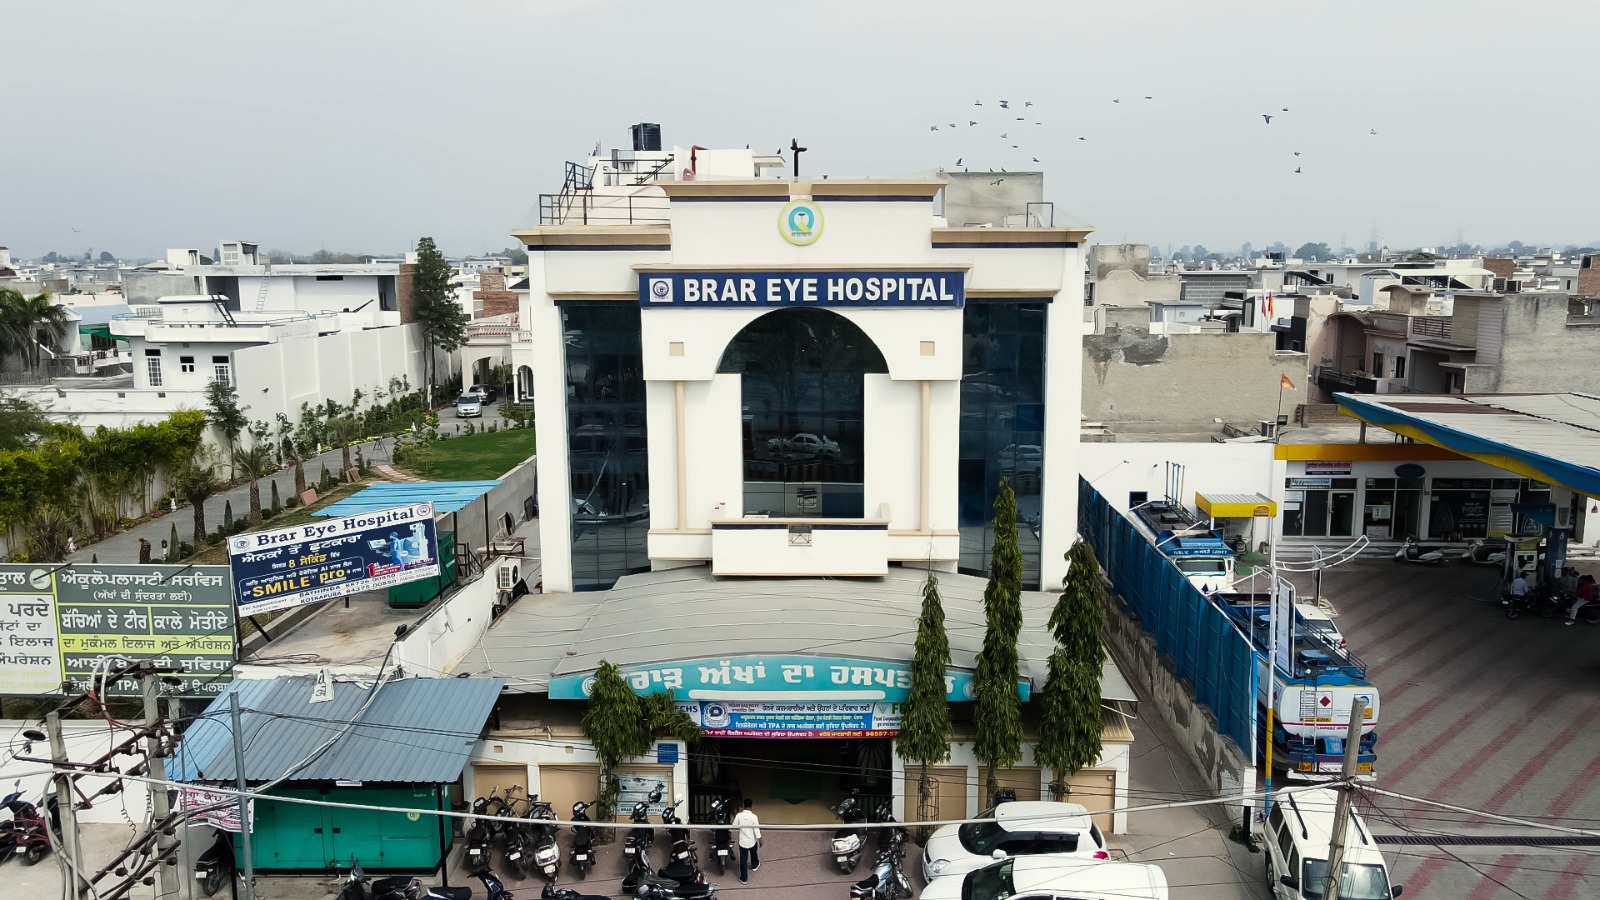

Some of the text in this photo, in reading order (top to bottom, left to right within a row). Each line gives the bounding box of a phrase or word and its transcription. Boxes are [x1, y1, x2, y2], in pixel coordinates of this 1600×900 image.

[684, 277, 954, 302] BRAR EYE HOSPITAL
[256, 507, 415, 547] Brar Eye Hospital
[241, 548, 283, 563] ਐਨਕਾਂ
[288, 559, 295, 568] 8
[171, 571, 223, 587] ਸਰਵਿਸ
[252, 575, 311, 598] SMILE
[319, 568, 345, 584] pro
[120, 589, 131, 600] ਦੀ
[300, 591, 342, 604] KOTKAPURA
[8, 598, 50, 617] ਪਰਦੇ
[26, 621, 42, 632] ਦਾ
[61, 607, 147, 630] ਬੱਚਿਆਂ ਦੇ ਟੀਰ
[153, 609, 229, 631] ਕਾਲੇ ਮੋਤੀਏ
[9, 634, 54, 647] ਇਲਾਜ
[63, 638, 75, 649] ਦਾ
[80, 635, 117, 651] ਮੁਕੰਮਲ
[122, 635, 155, 649] ਇਲਾਜ
[160, 636, 181, 650] ਅਤੇ
[622, 668, 684, 690] ਰਾੜ
[698, 660, 766, 685] ਅੱਖਾਂ
[781, 664, 814, 684] ਦਾ
[116, 680, 139, 691] TPA
